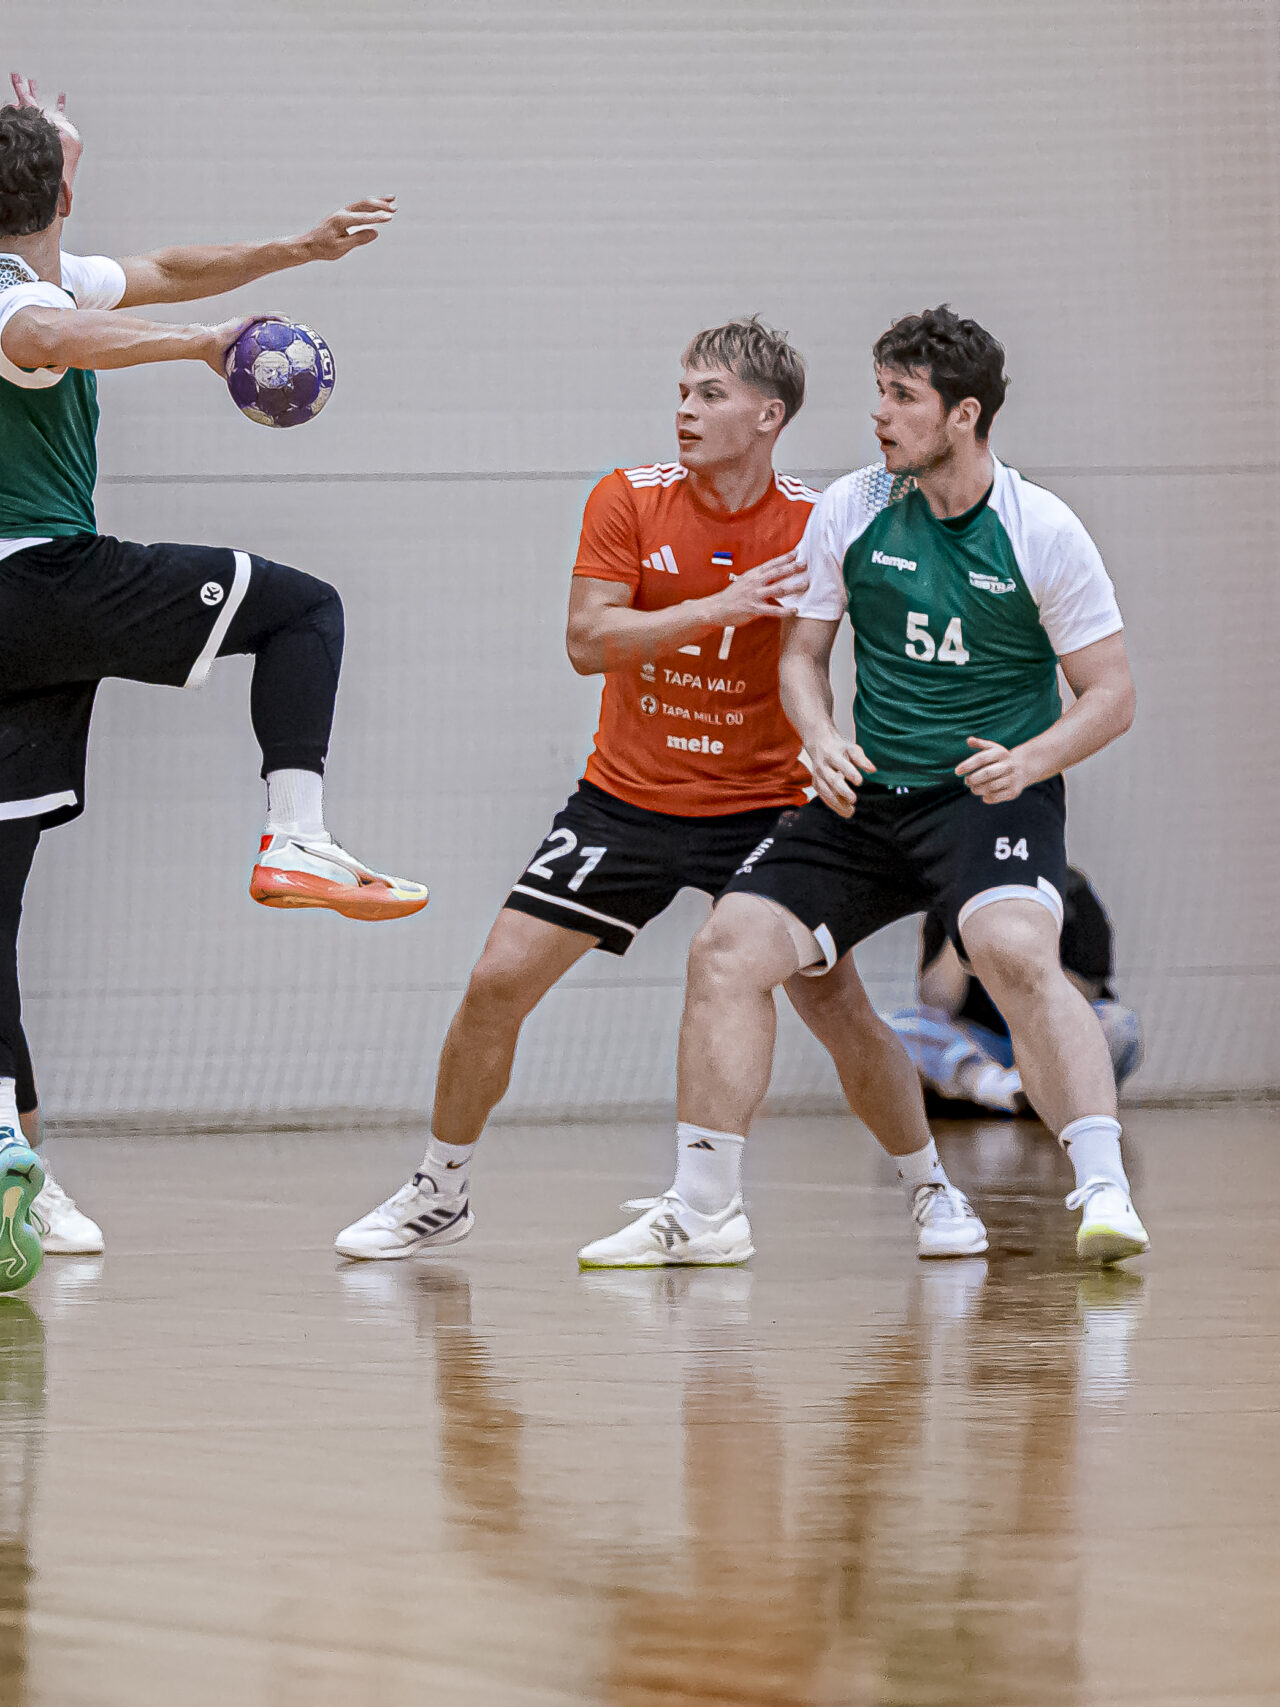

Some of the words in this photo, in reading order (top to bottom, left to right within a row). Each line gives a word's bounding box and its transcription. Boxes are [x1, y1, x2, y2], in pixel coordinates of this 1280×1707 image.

[871, 550, 918, 572] Kempa
[905, 611, 970, 665] 54
[664, 668, 702, 690] TAPA
[707, 676, 746, 694] VALD
[662, 702, 692, 720] TAPA
[693, 710, 723, 726] MILL
[666, 734, 725, 755] meie
[994, 836, 1029, 861] 54
